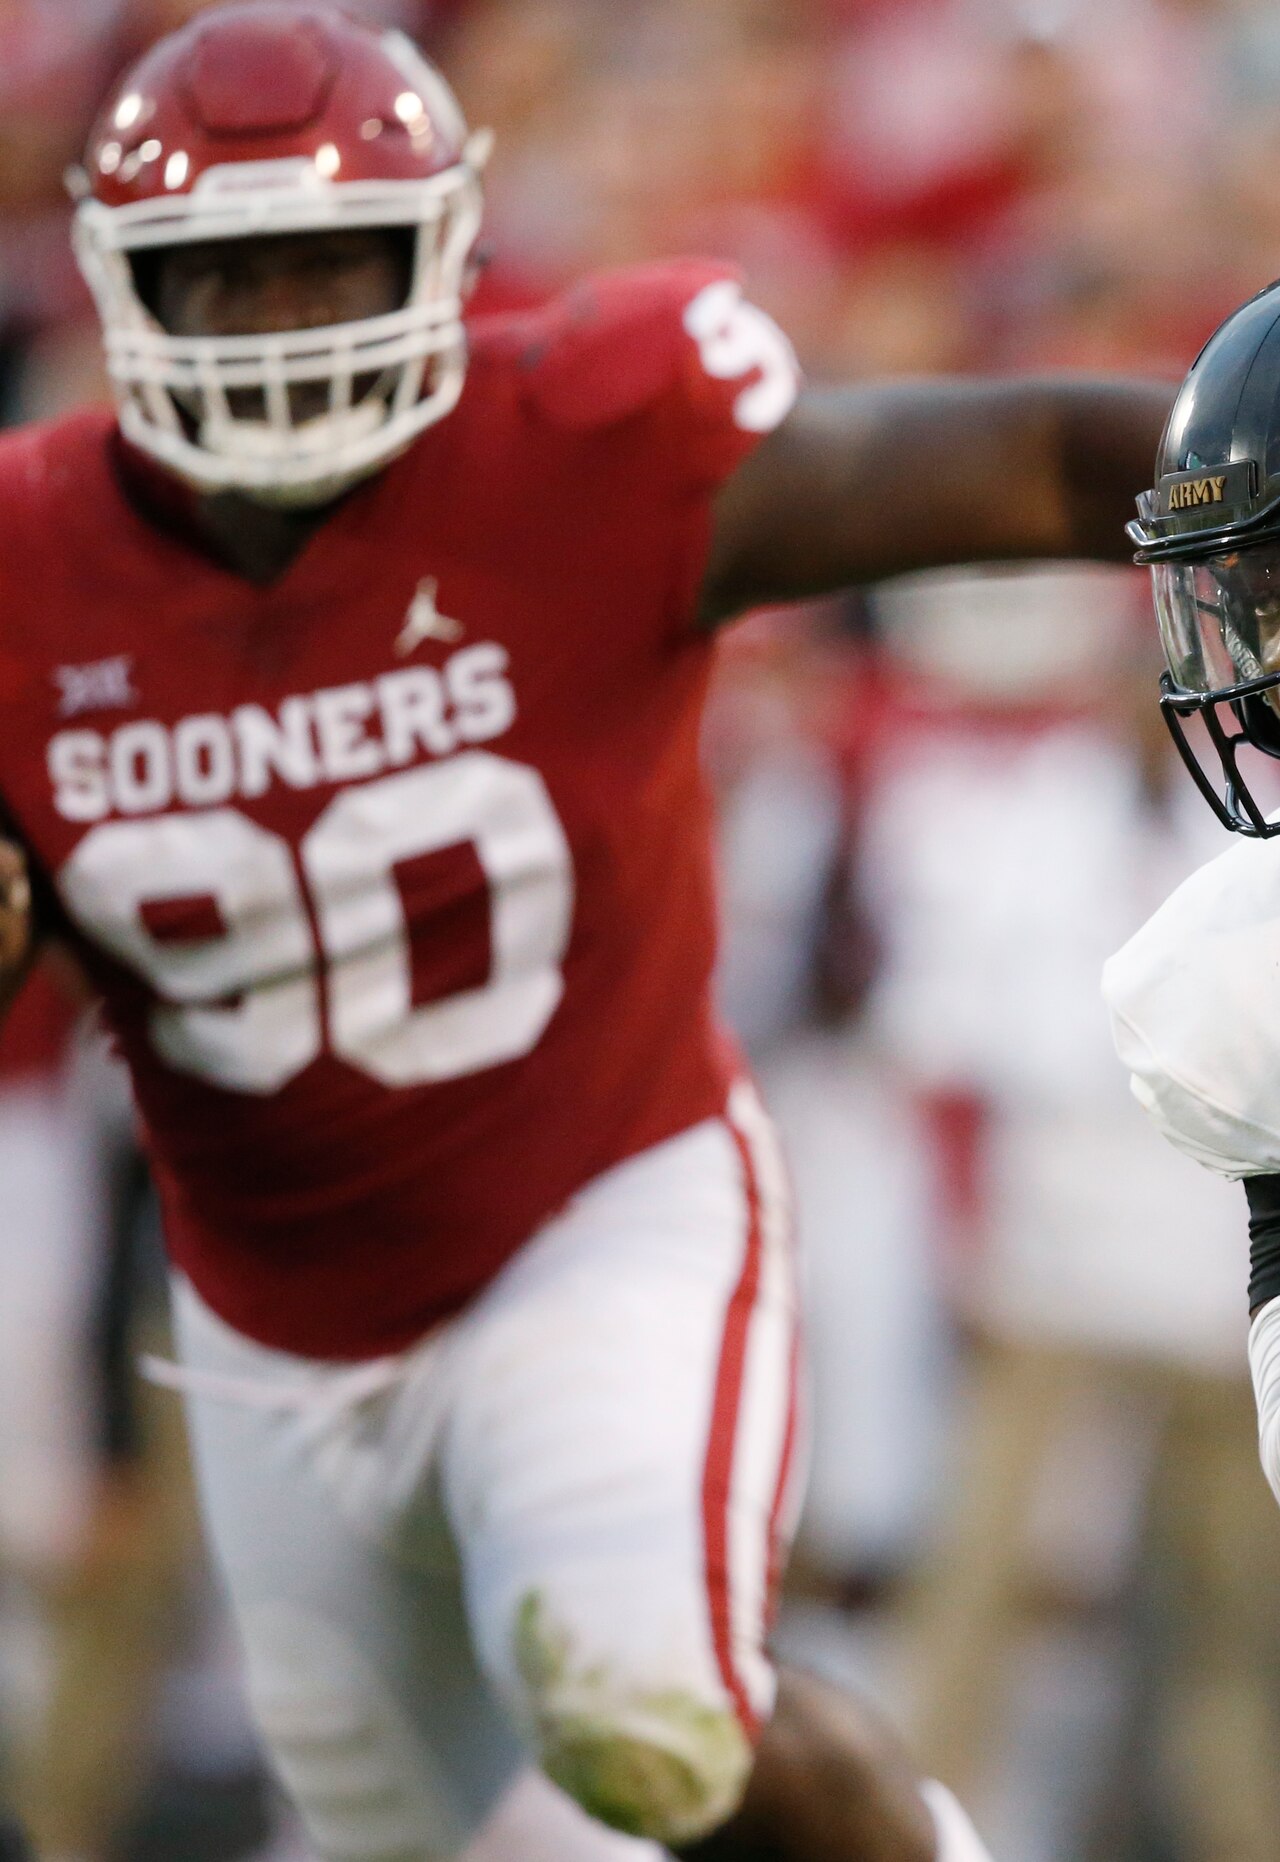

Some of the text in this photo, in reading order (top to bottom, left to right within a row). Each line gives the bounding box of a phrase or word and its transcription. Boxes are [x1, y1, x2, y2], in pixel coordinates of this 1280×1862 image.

[1168, 475, 1226, 511] ARMY
[47, 640, 516, 822] SOONERS
[58, 749, 575, 1097] 90
